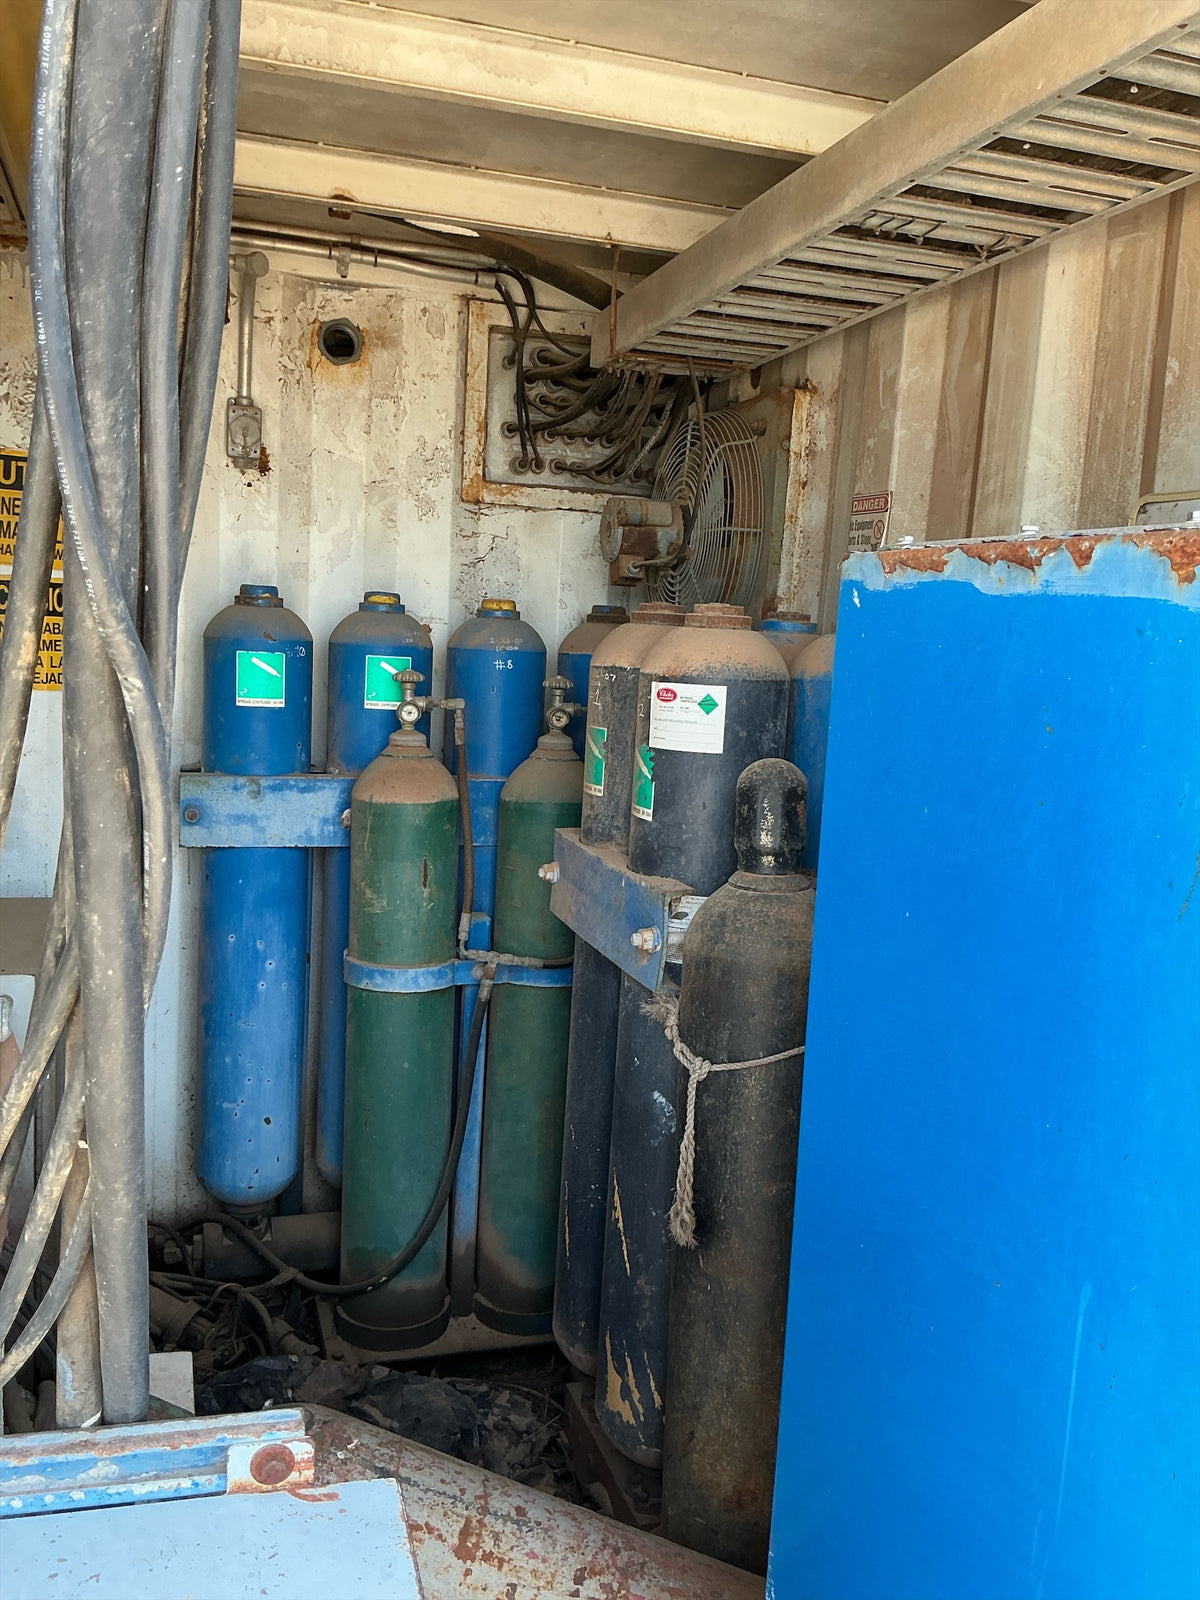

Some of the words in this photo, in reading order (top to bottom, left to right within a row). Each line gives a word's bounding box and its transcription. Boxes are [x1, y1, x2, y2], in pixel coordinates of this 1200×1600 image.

[852, 498, 885, 511] DANGER
[66, 504, 78, 527] TYPE
[84, 578, 95, 598] SPEC
[493, 659, 514, 671] #8
